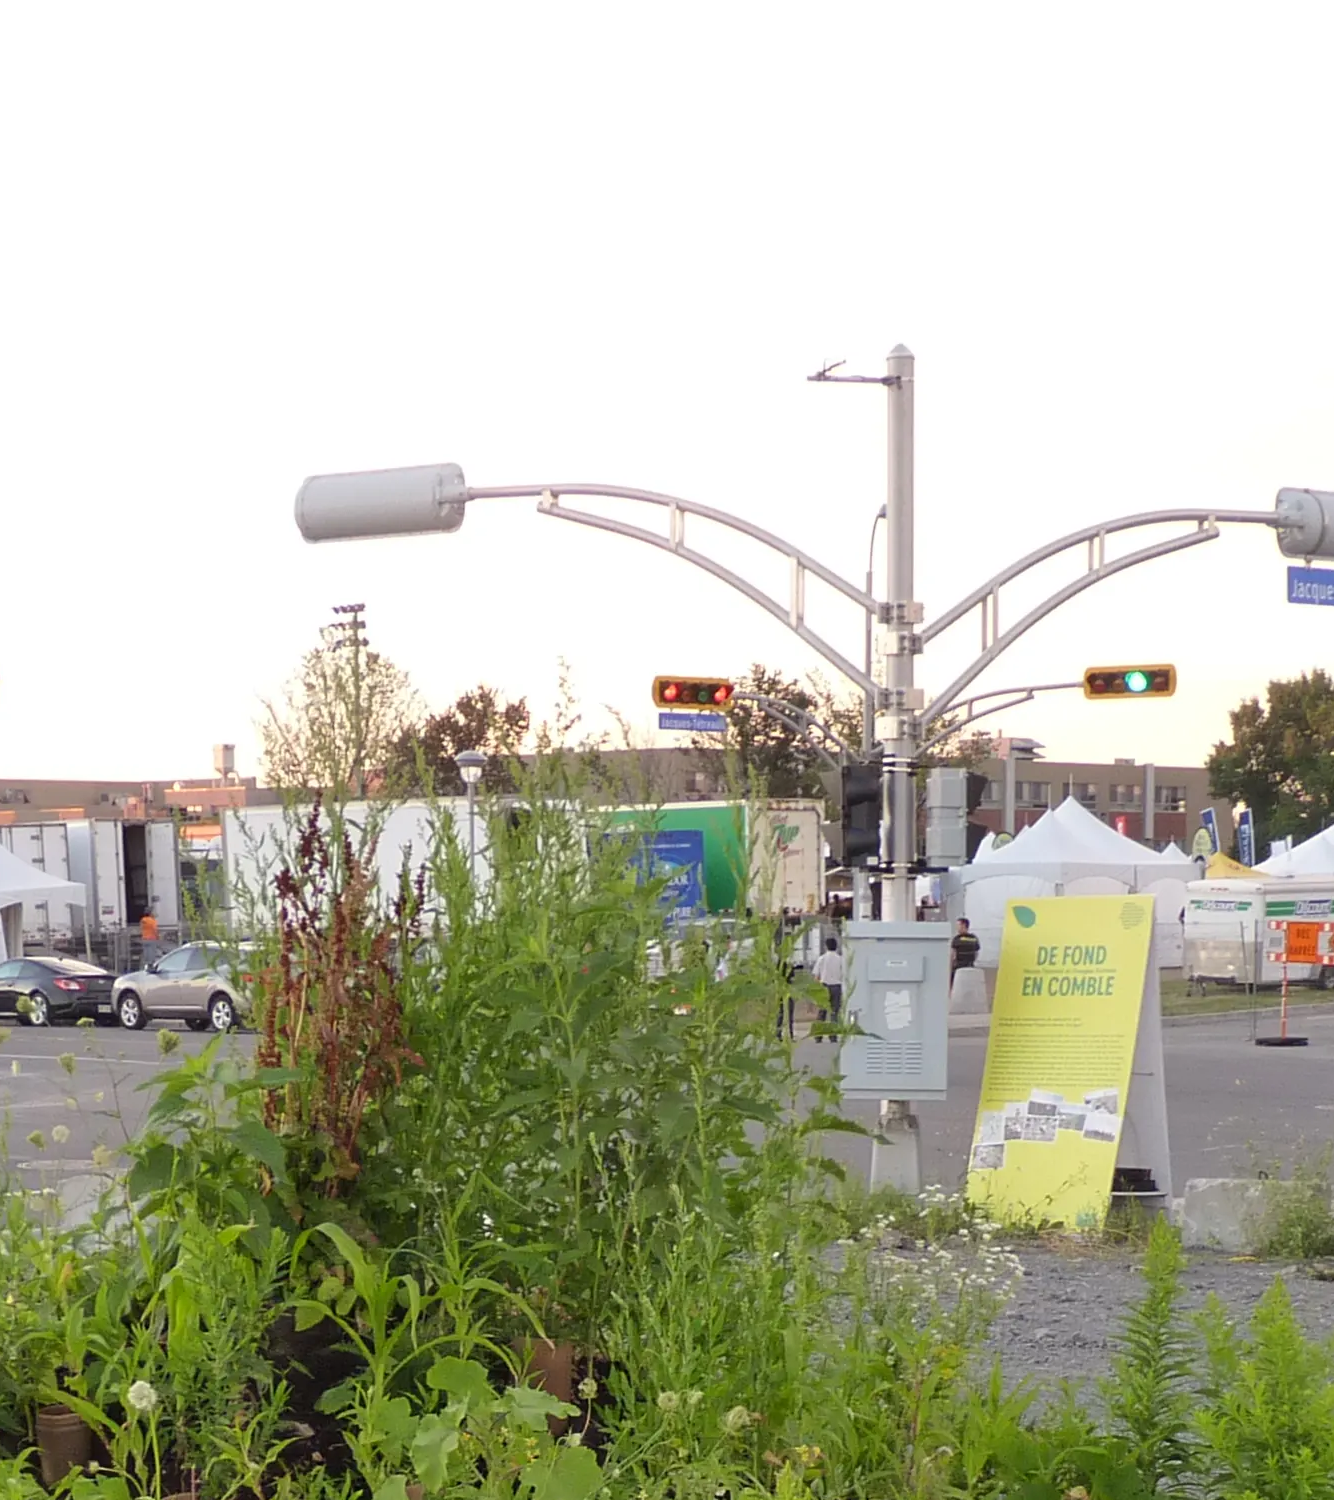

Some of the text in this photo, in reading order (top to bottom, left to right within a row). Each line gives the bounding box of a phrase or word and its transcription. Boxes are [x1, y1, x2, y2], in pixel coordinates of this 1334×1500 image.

[1037, 945, 1107, 965] DE FOND
[1022, 976, 1115, 996] EN COMBLE
